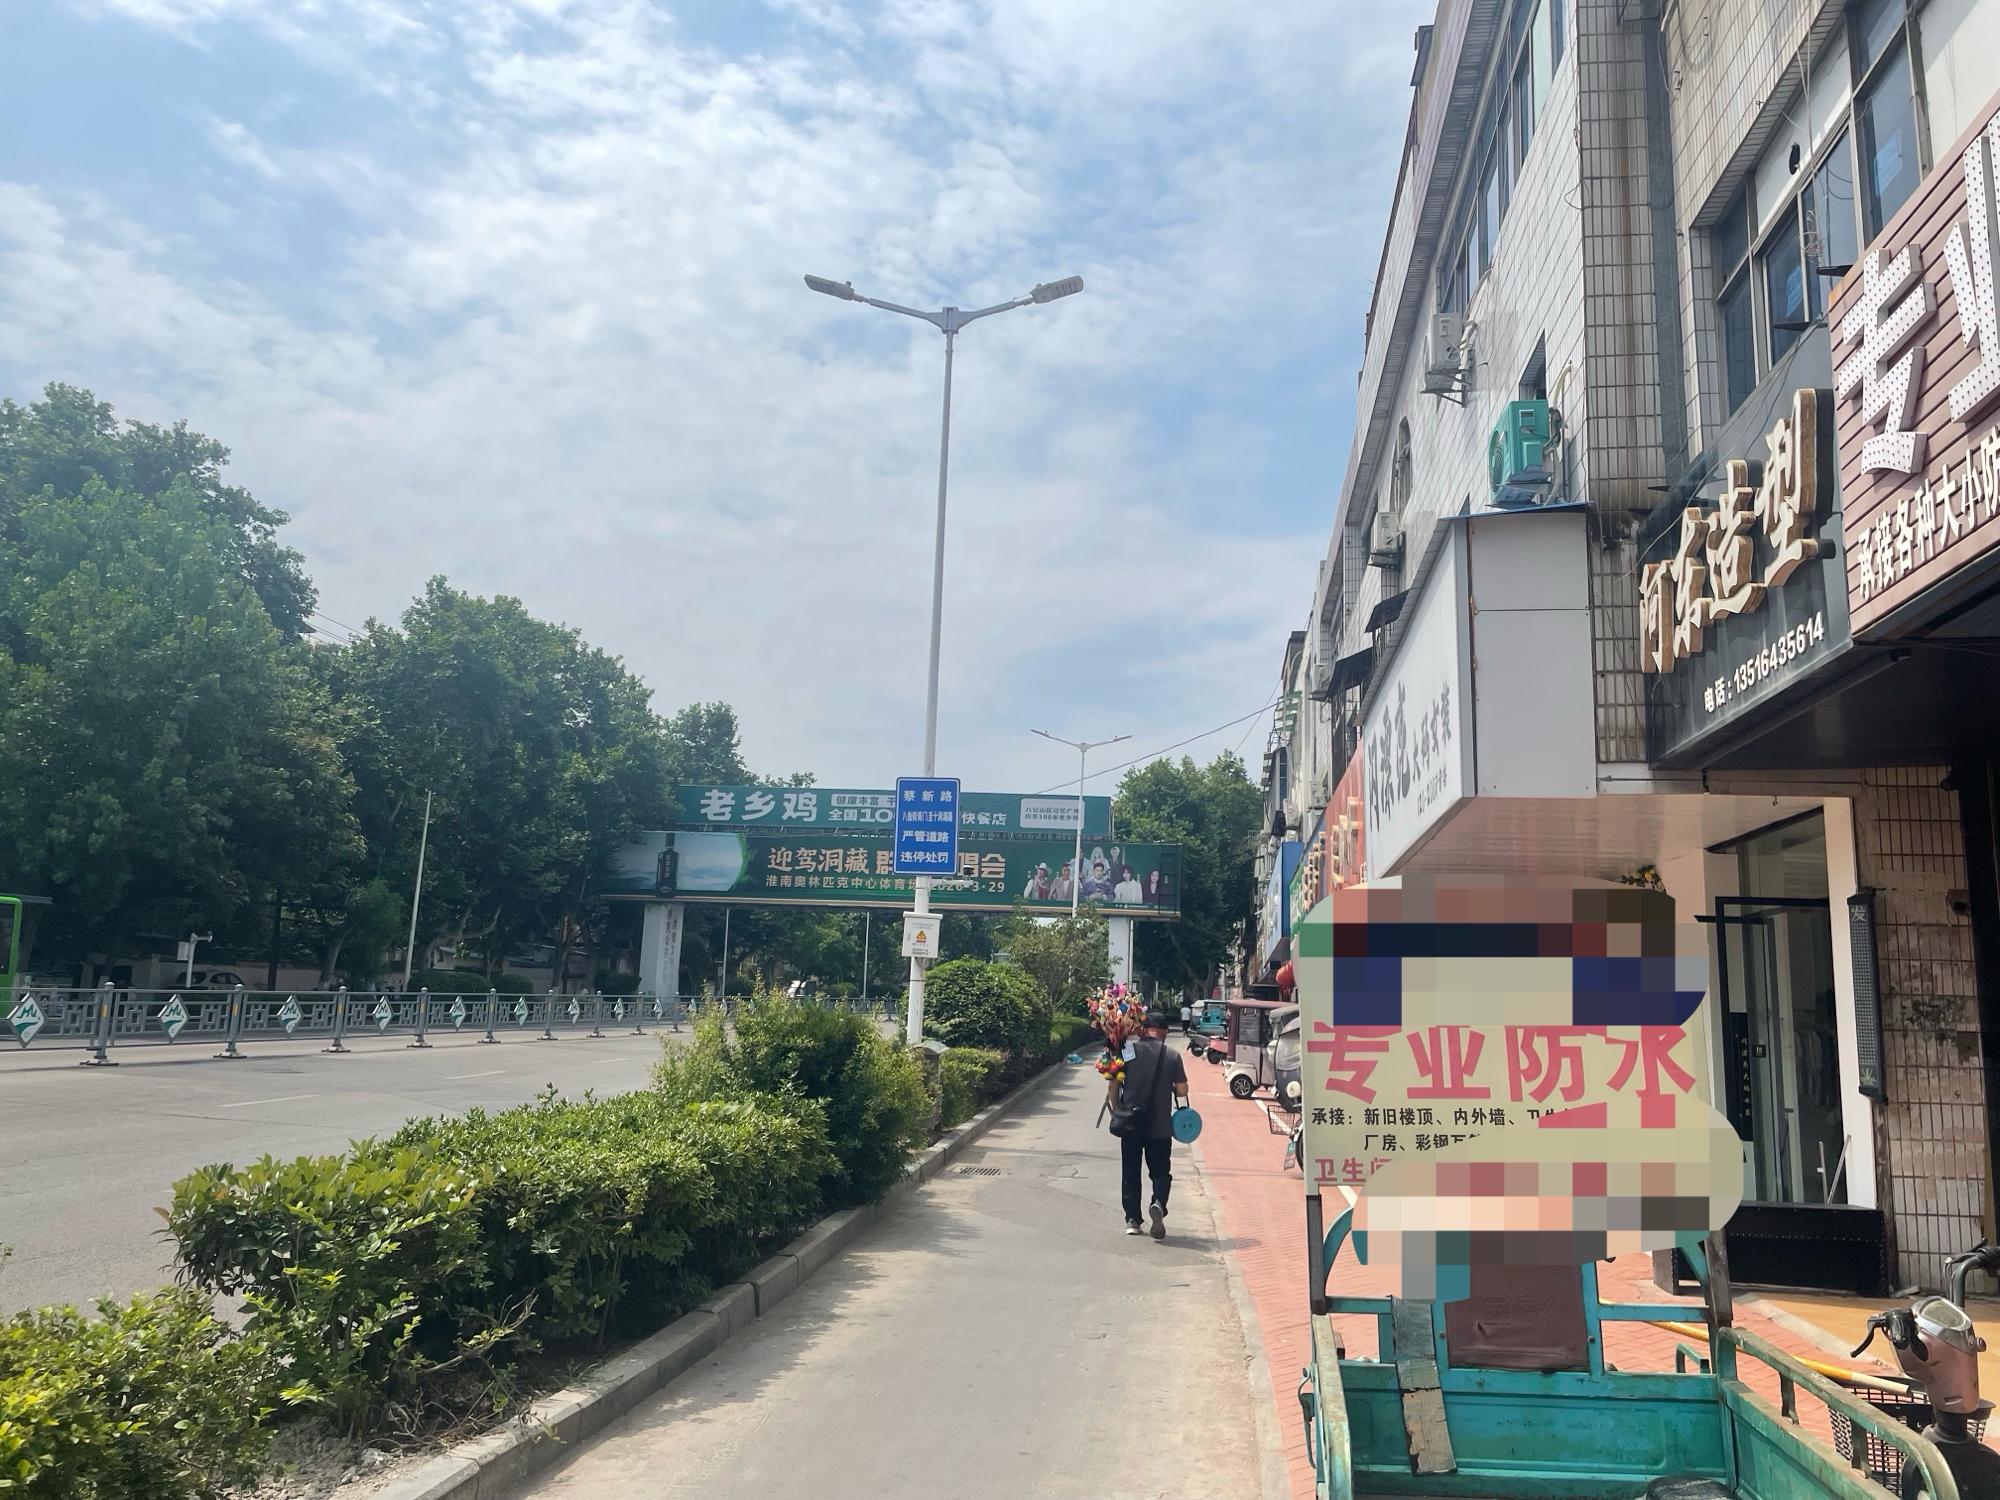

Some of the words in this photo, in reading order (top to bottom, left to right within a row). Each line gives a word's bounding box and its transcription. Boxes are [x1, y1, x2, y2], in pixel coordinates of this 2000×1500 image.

[836, 796, 879, 806] 健康丰富
[903, 790, 953, 802] 蔡新路
[700, 789, 817, 822] 老乡鸡
[828, 808, 895, 823] 全国10
[961, 811, 1007, 826] 快餐店
[901, 830, 950, 843] 严管道路
[767, 846, 869, 874] 迎驾洞藏
[900, 851, 949, 864] 违停处罚
[1851, 905, 1867, 922] 发
[1307, 1022, 1697, 1104] 专业防水
